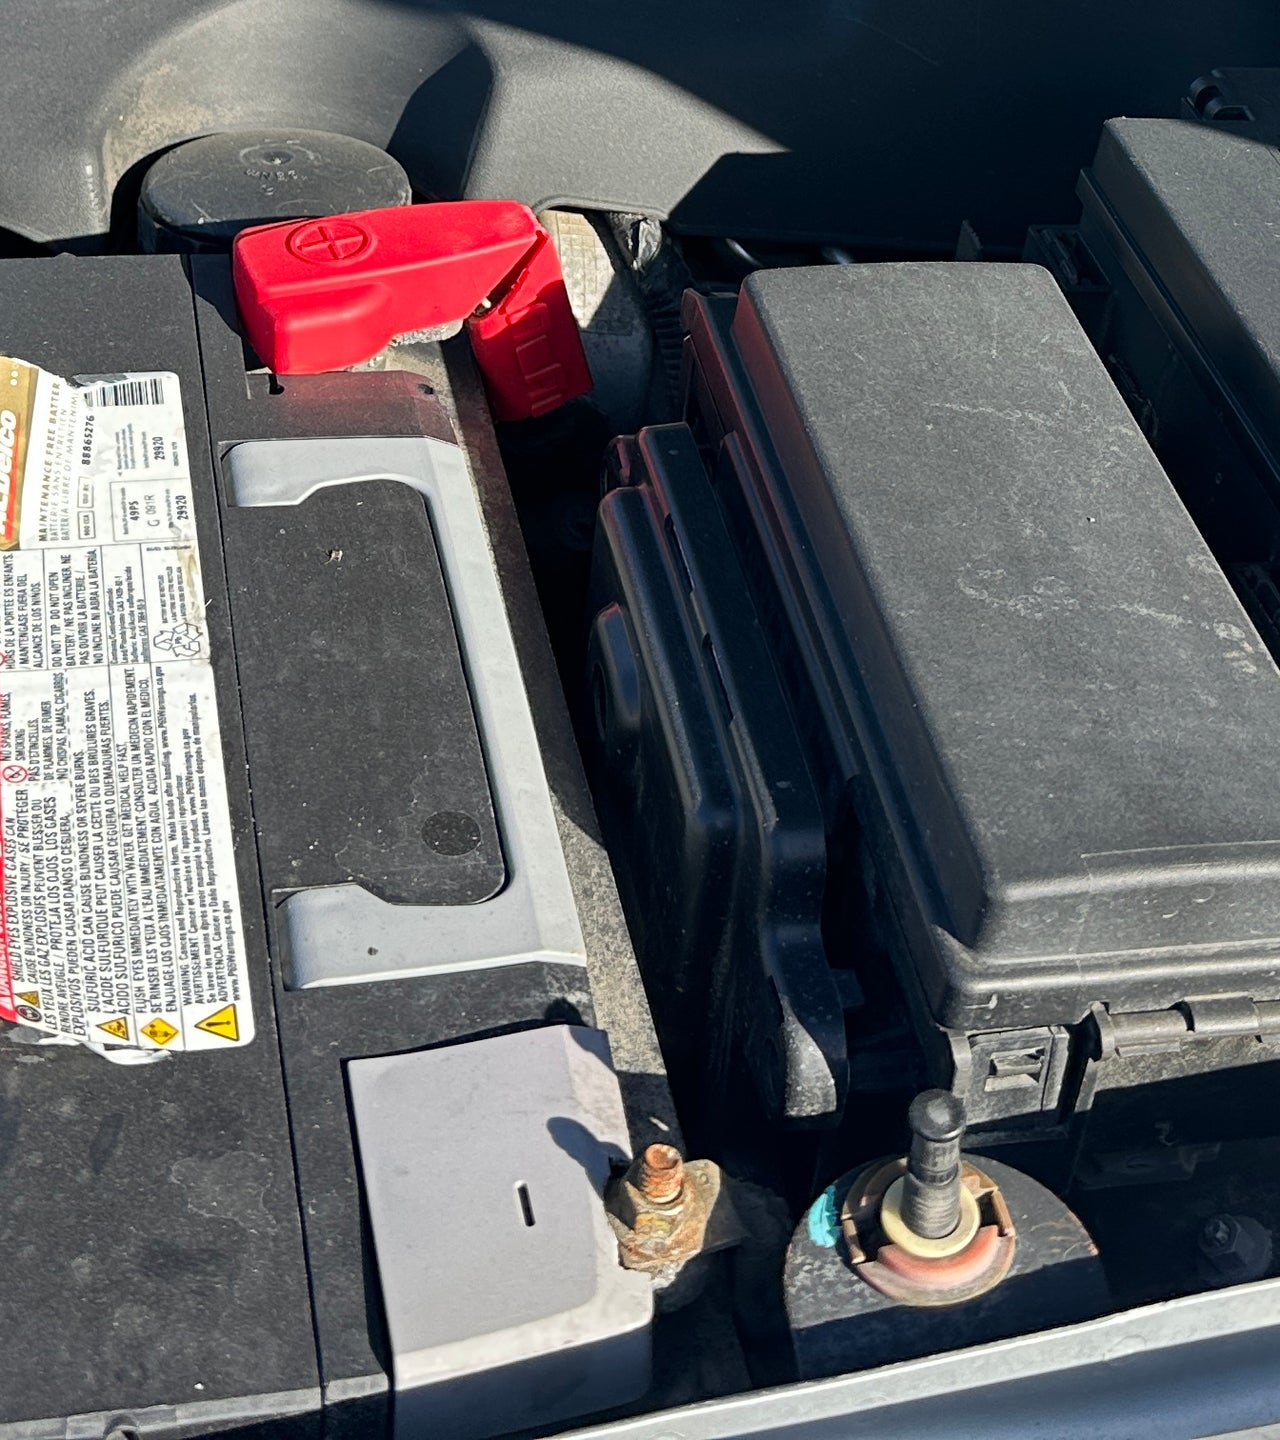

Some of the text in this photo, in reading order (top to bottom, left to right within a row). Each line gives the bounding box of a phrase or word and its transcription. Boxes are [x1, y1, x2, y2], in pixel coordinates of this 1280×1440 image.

[44, 429, 56, 456] FREE
[81, 414, 95, 466] 88865276
[152, 436, 165, 460] 29920
[38, 460, 53, 542] MAINTENANCE
[52, 470, 62, 496] SANS
[61, 476, 71, 504] LIBRE
[130, 500, 140, 521] 49PS
[175, 494, 189, 520] 29920
[49, 501, 59, 541] BATTERIE
[48, 572, 61, 654] NOT DO NOT OPEN
[60, 554, 74, 627] NE PAS NE
[89, 581, 99, 589] LA
[90, 591, 101, 610] ABRA
[4, 628, 14, 636] LA
[32, 608, 43, 668] ALCANCE DE LOS
[76, 612, 89, 665] PAS OUVRIR LA
[92, 622, 103, 651] INCLINE
[93, 653, 103, 664] NO
[141, 710, 162, 843] CON ACUDA CON EL
[102, 738, 122, 918] PUEDE CAUSAR CEGUERA QUEMADURAS
[167, 821, 177, 841] Wash
[74, 782, 100, 1012] SULFURIC ACID CAN CAUSE BLINDNESS OR SEVERE
[89, 768, 113, 972] SULFURIQUE PEUT CAUSER LA OU DES
[118, 764, 148, 1013] FLUSH EYES IMMEDIATELY WITH GET MEDICAL HELP
[132, 753, 162, 1013] SE RINSER LES YEUX CONSULTER UN
[4, 817, 24, 982] SHIELD EYES EXPLOSIVE CAN
[20, 861, 38, 984] CAUSE BLINDNESS OR INJURY
[31, 799, 55, 1011] YEUX LES GAZ EXPLOSIFS PEUVENT OU
[43, 796, 72, 1033] RENDRE PROTEJA LOS GASES
[61, 901, 86, 1036] EXPLOSIVOS PUEDEN CAUSAR
